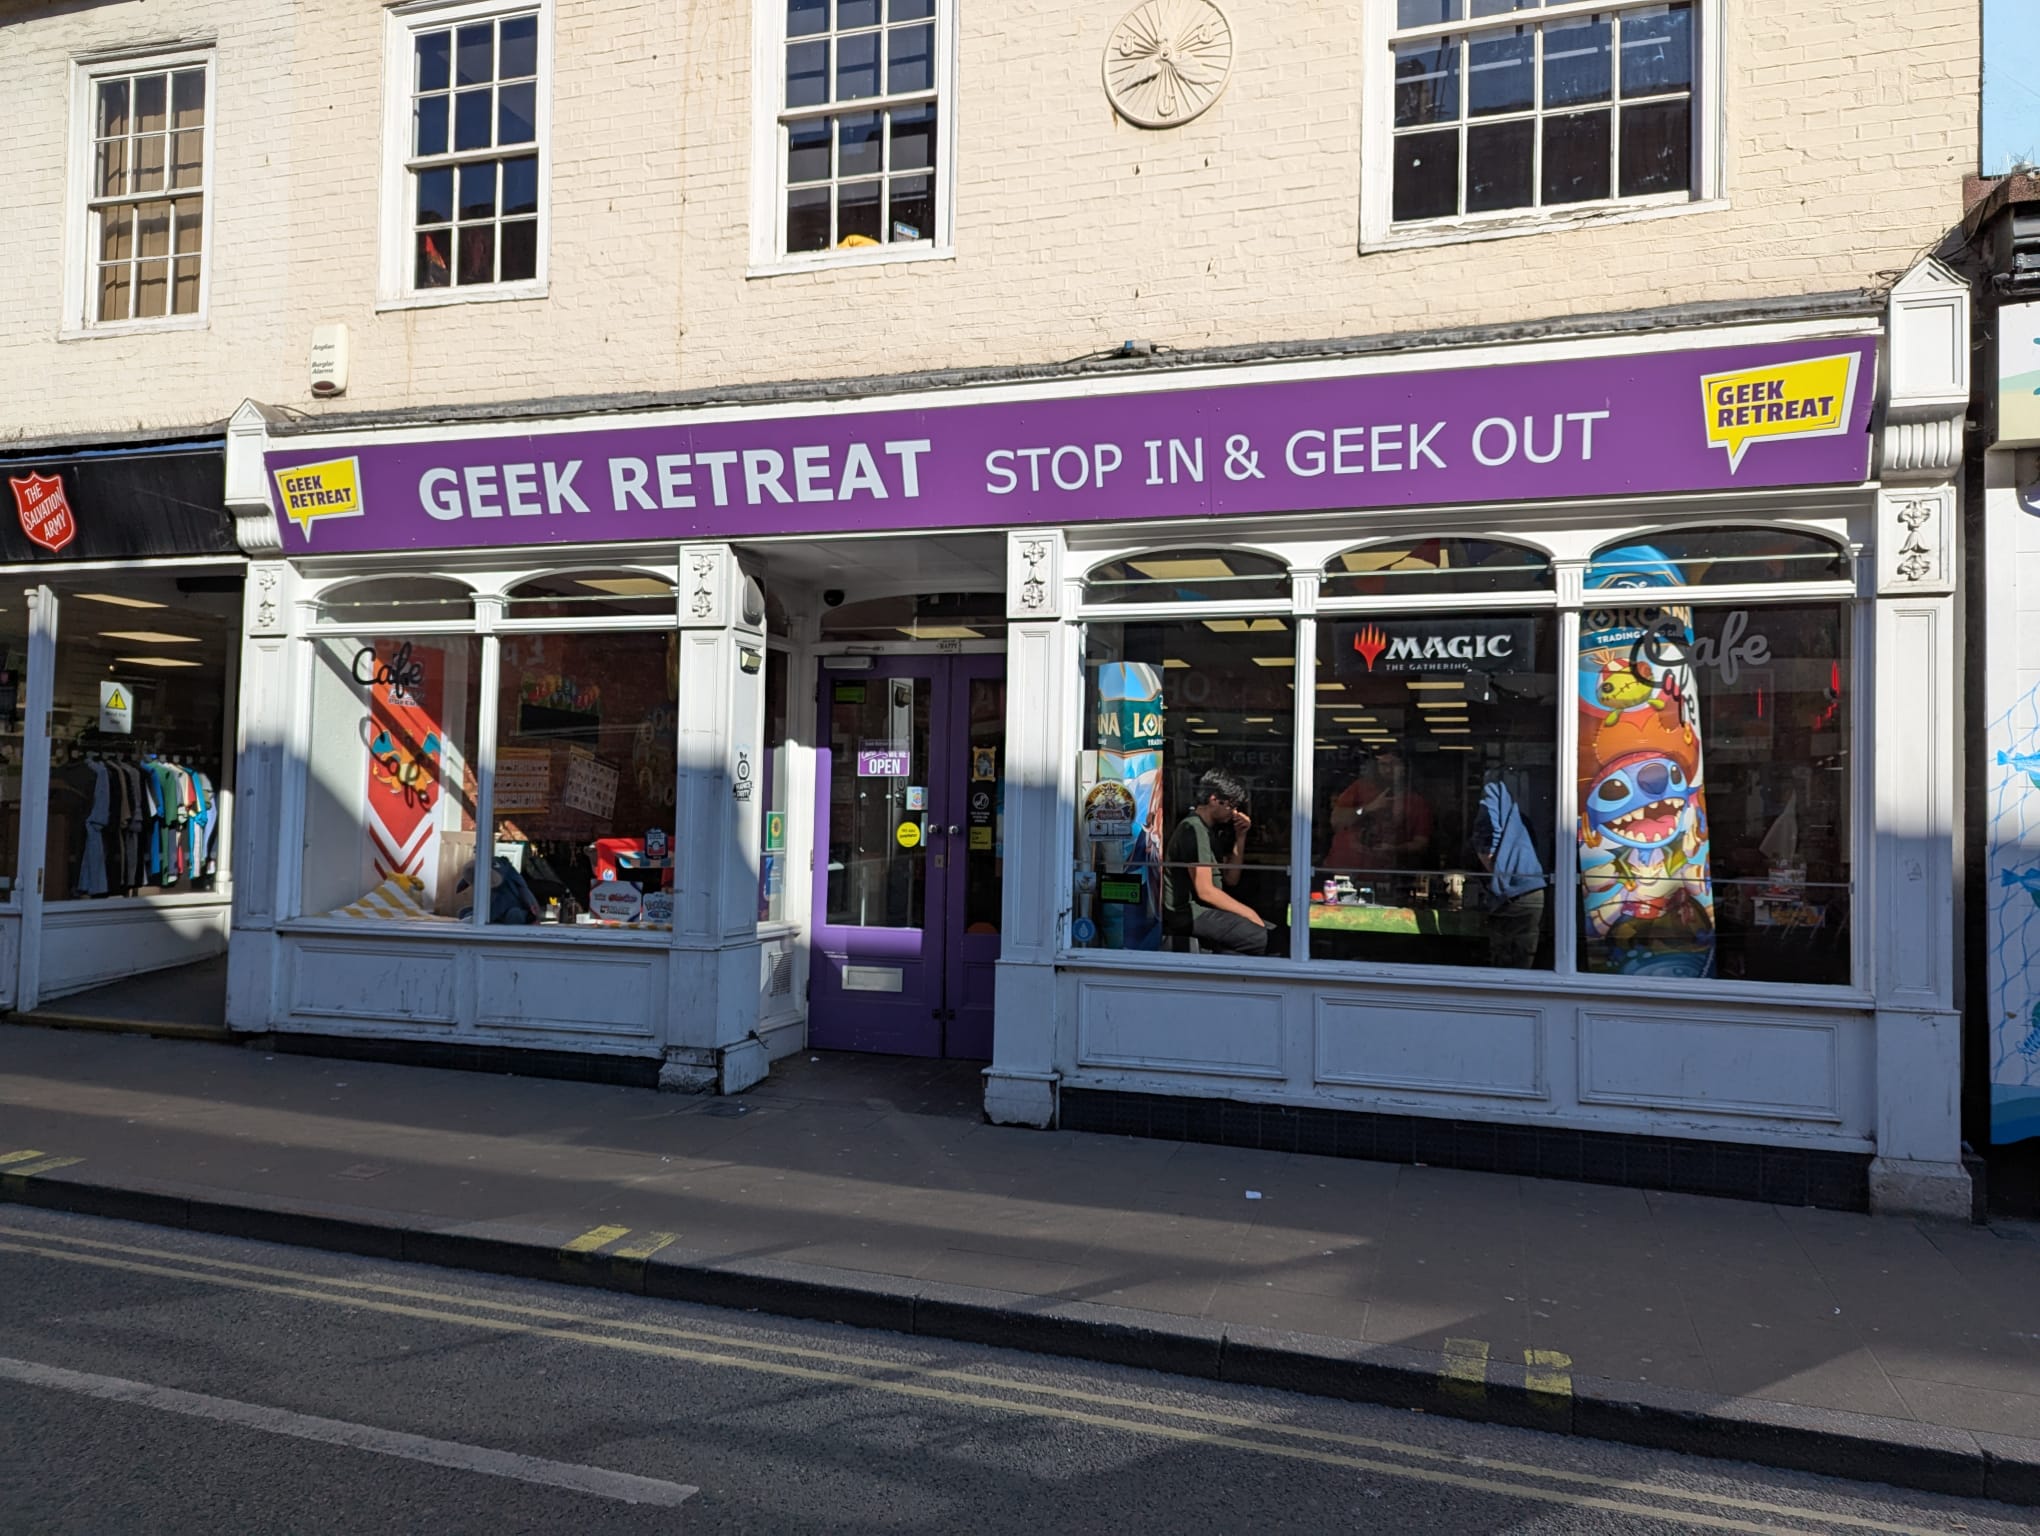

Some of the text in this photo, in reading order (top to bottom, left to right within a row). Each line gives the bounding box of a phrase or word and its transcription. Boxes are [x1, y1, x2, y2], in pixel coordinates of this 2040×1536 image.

[1717, 380, 1784, 406] GEEK
[1718, 396, 1834, 427] RETREAT
[985, 410, 1610, 494] STOP IN & GEEK OUT
[286, 475, 322, 493] GEEK
[419, 439, 931, 520] GEEK RETREAT
[24, 482, 43, 505] THE
[289, 488, 351, 509] RETREAT
[23, 486, 64, 531] SALVATION
[43, 509, 66, 541] ARMY
[1385, 634, 1513, 661] MAGIC
[1596, 631, 1641, 644] TRADING
[1644, 611, 1771, 685] Cafe
[352, 641, 423, 699] Cafe
[1409, 663, 1469, 671] GATHERING
[869, 759, 900, 774] OPEN
